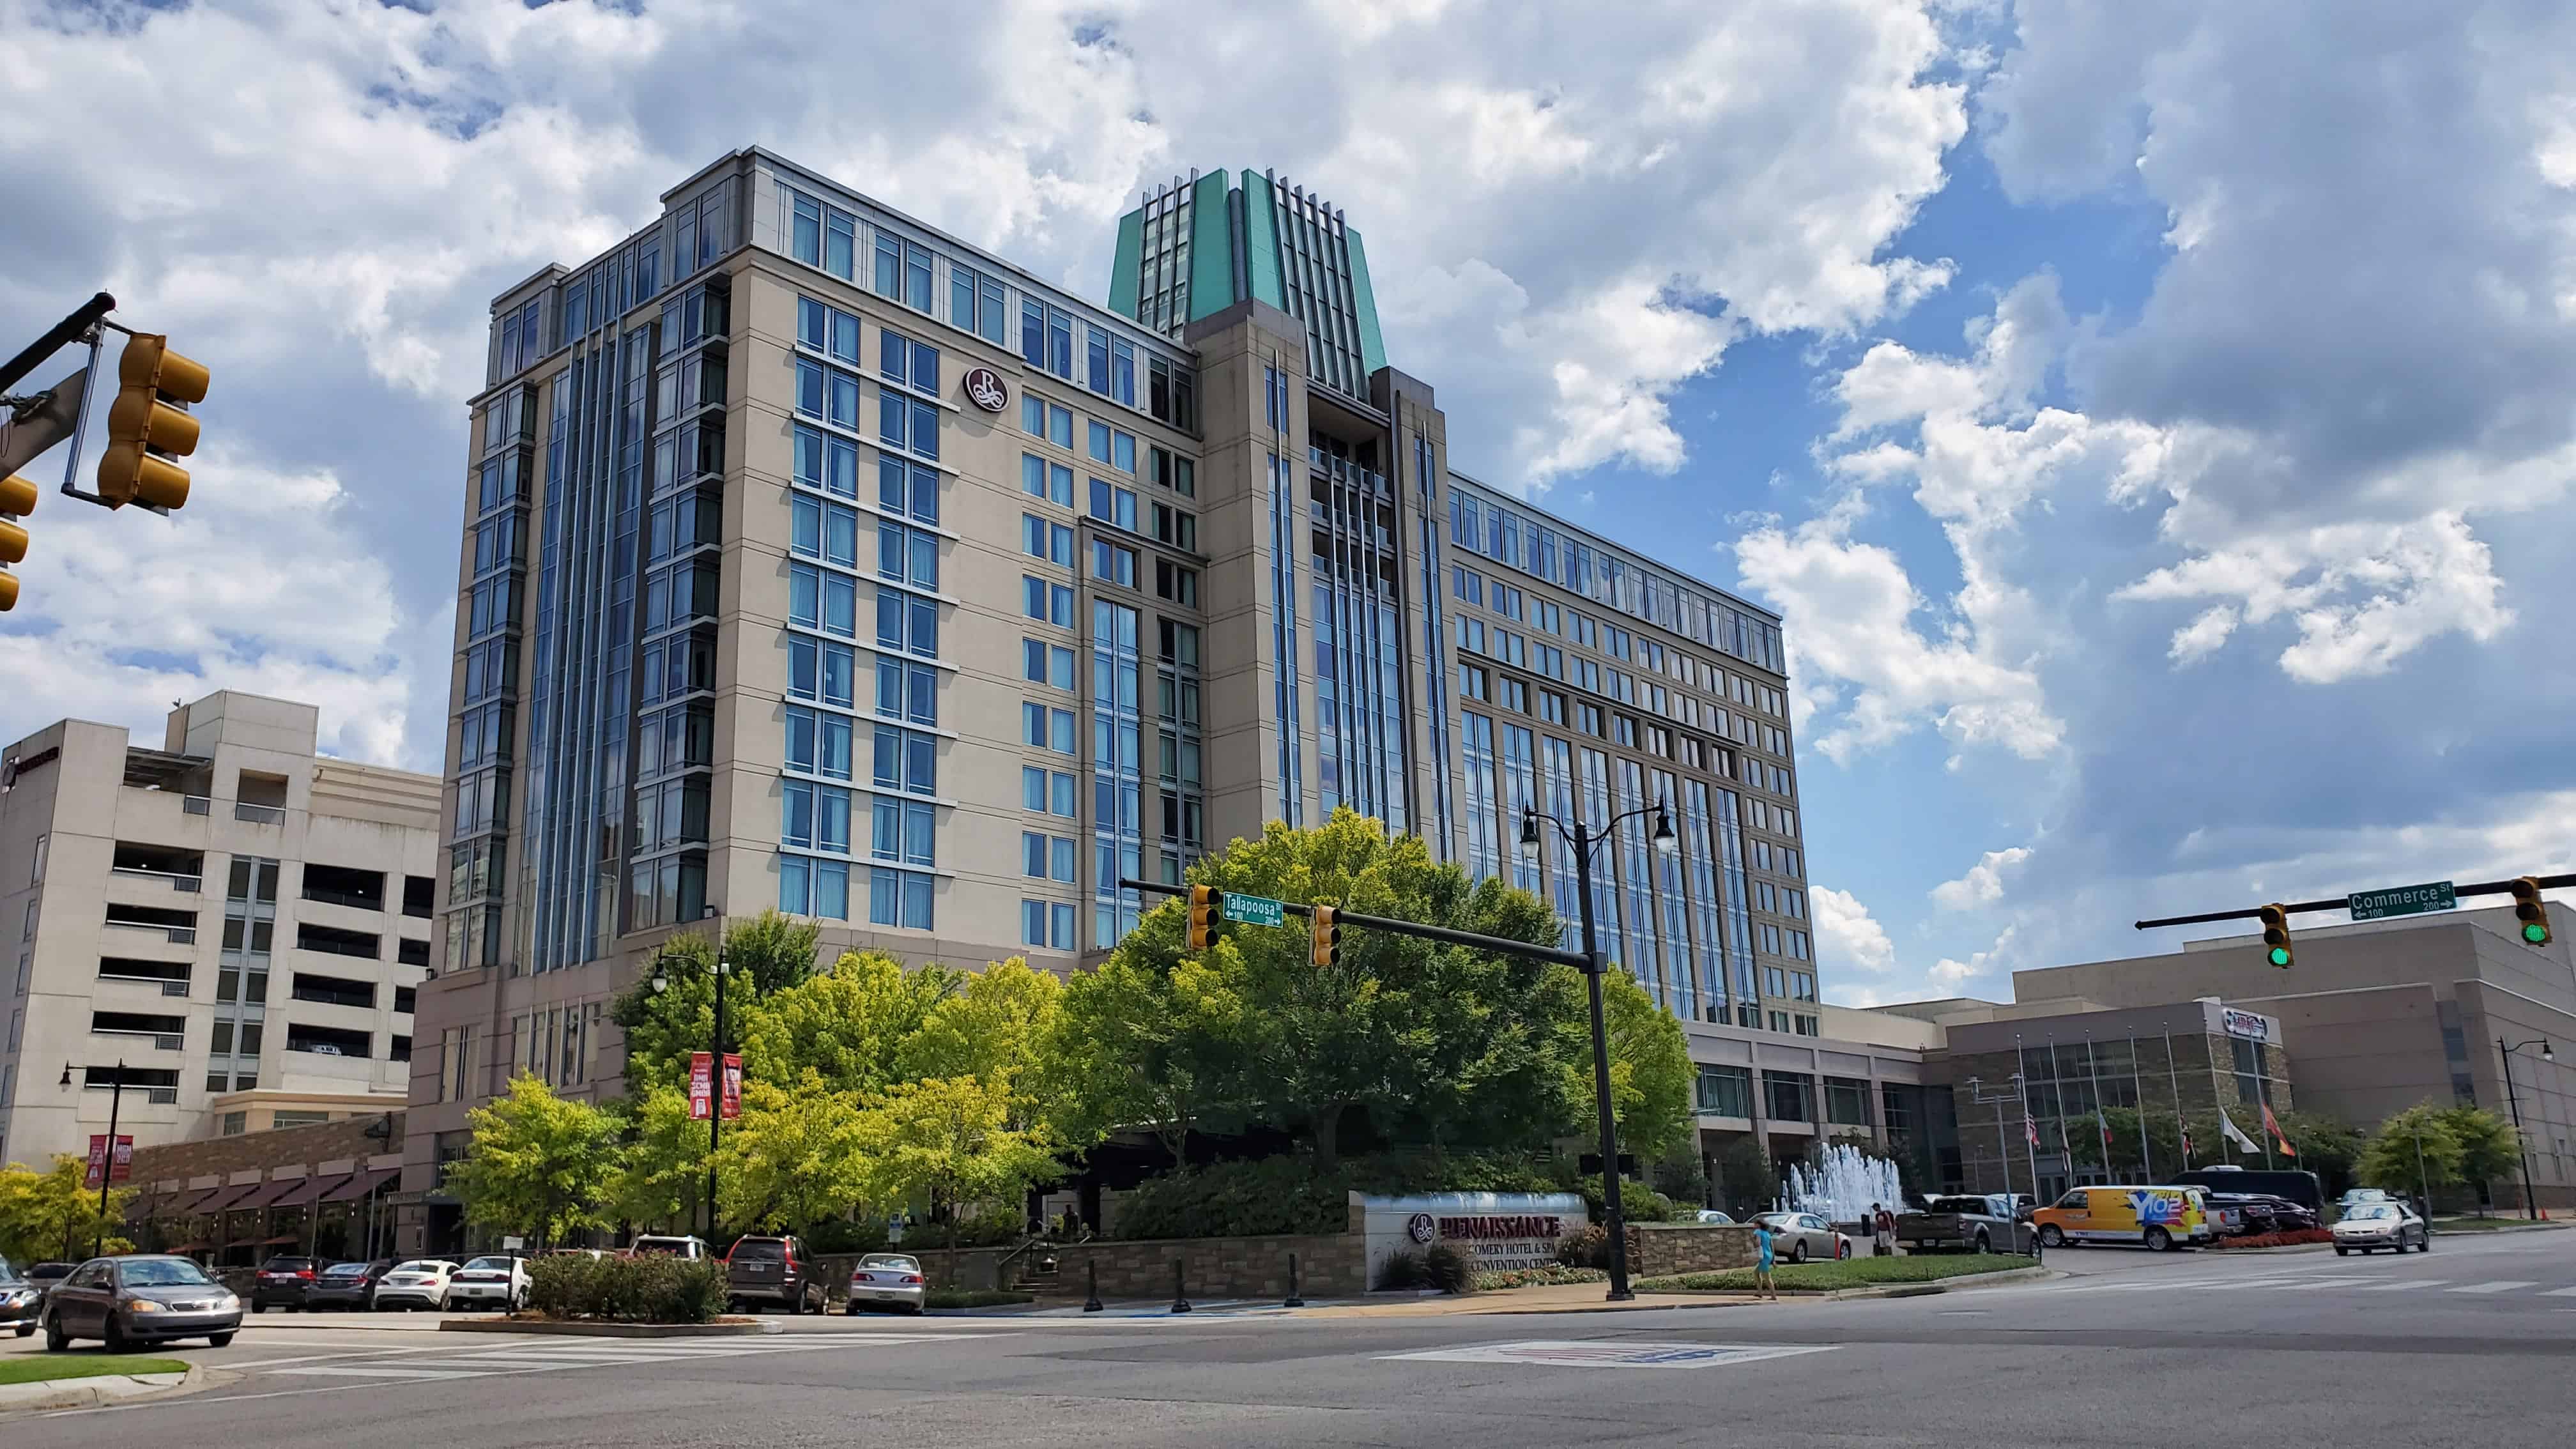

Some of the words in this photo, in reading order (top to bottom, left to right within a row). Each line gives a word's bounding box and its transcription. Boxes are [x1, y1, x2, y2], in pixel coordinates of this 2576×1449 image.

[2352, 888, 2438, 910] Commerce
[2440, 884, 2451, 893] St
[1225, 894, 1275, 916] Tallapoosa
[2423, 901, 2439, 911] 200
[1234, 911, 1243, 920] 100
[2368, 909, 2384, 918] 100
[1265, 916, 1274, 925] 200
[1440, 1216, 1561, 1238] RENAISSANCE
[1506, 1243, 1533, 1255] HOTEL
[1542, 1243, 1556, 1254] SPA
[1471, 1258, 1527, 1272] CONVENTION
